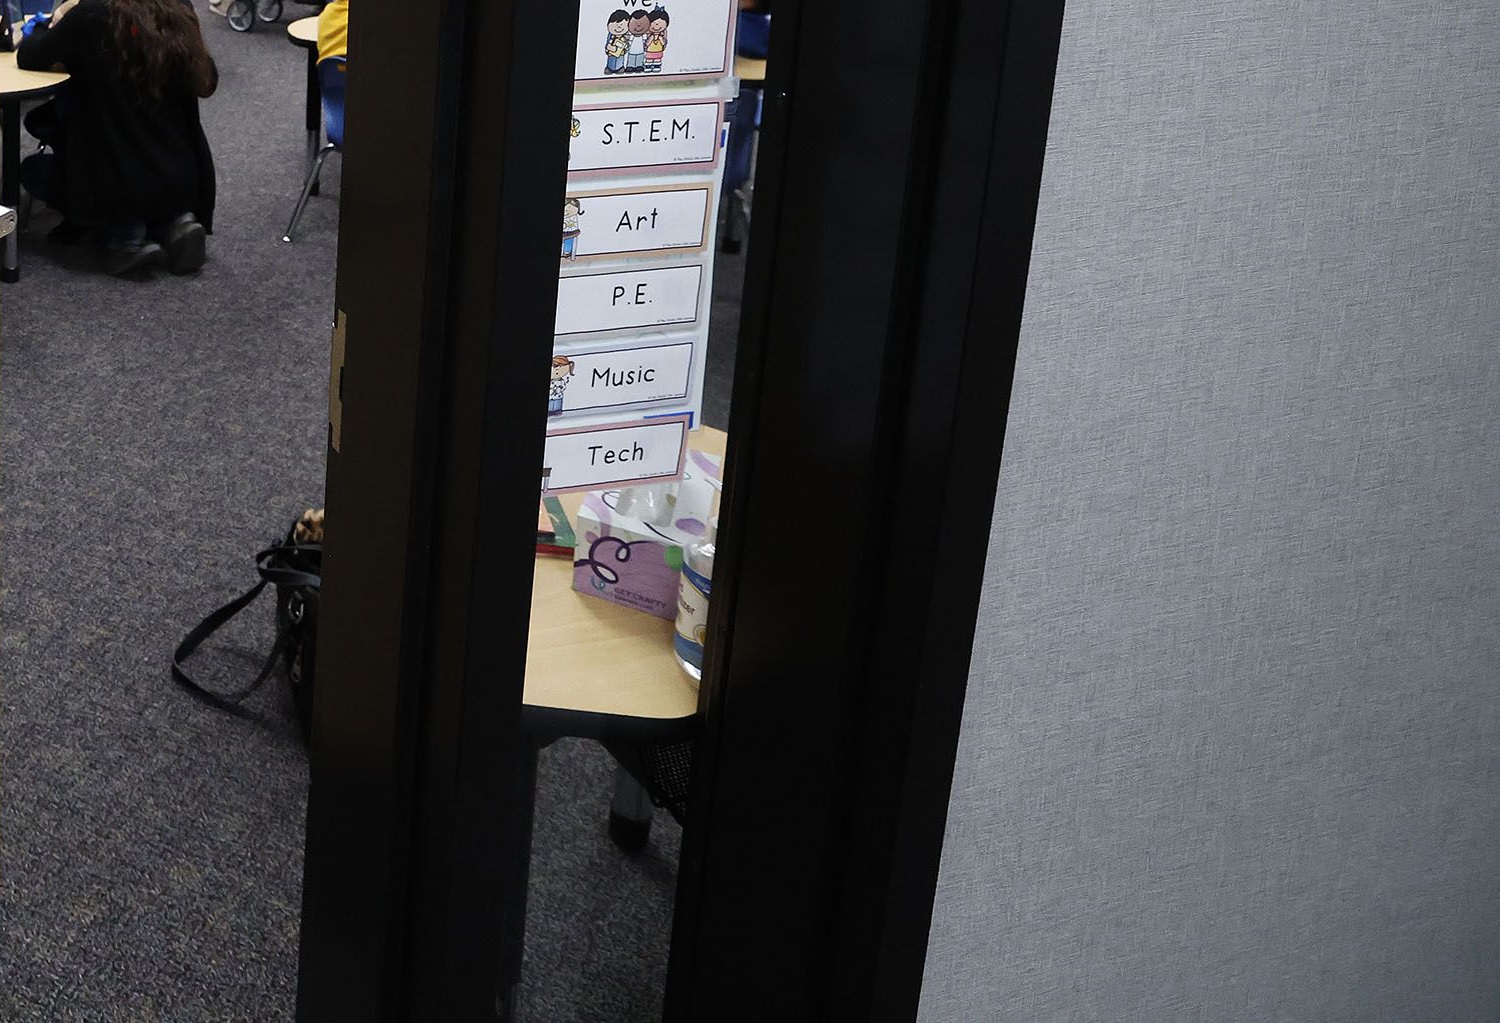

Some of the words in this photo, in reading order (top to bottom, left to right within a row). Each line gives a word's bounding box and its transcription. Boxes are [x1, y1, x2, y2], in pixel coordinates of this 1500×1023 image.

[602, 118, 696, 145] S.T.E.M.
[615, 207, 658, 232] Art
[612, 283, 654, 306] P.E.
[591, 365, 656, 388] Music
[587, 441, 645, 466] Tech
